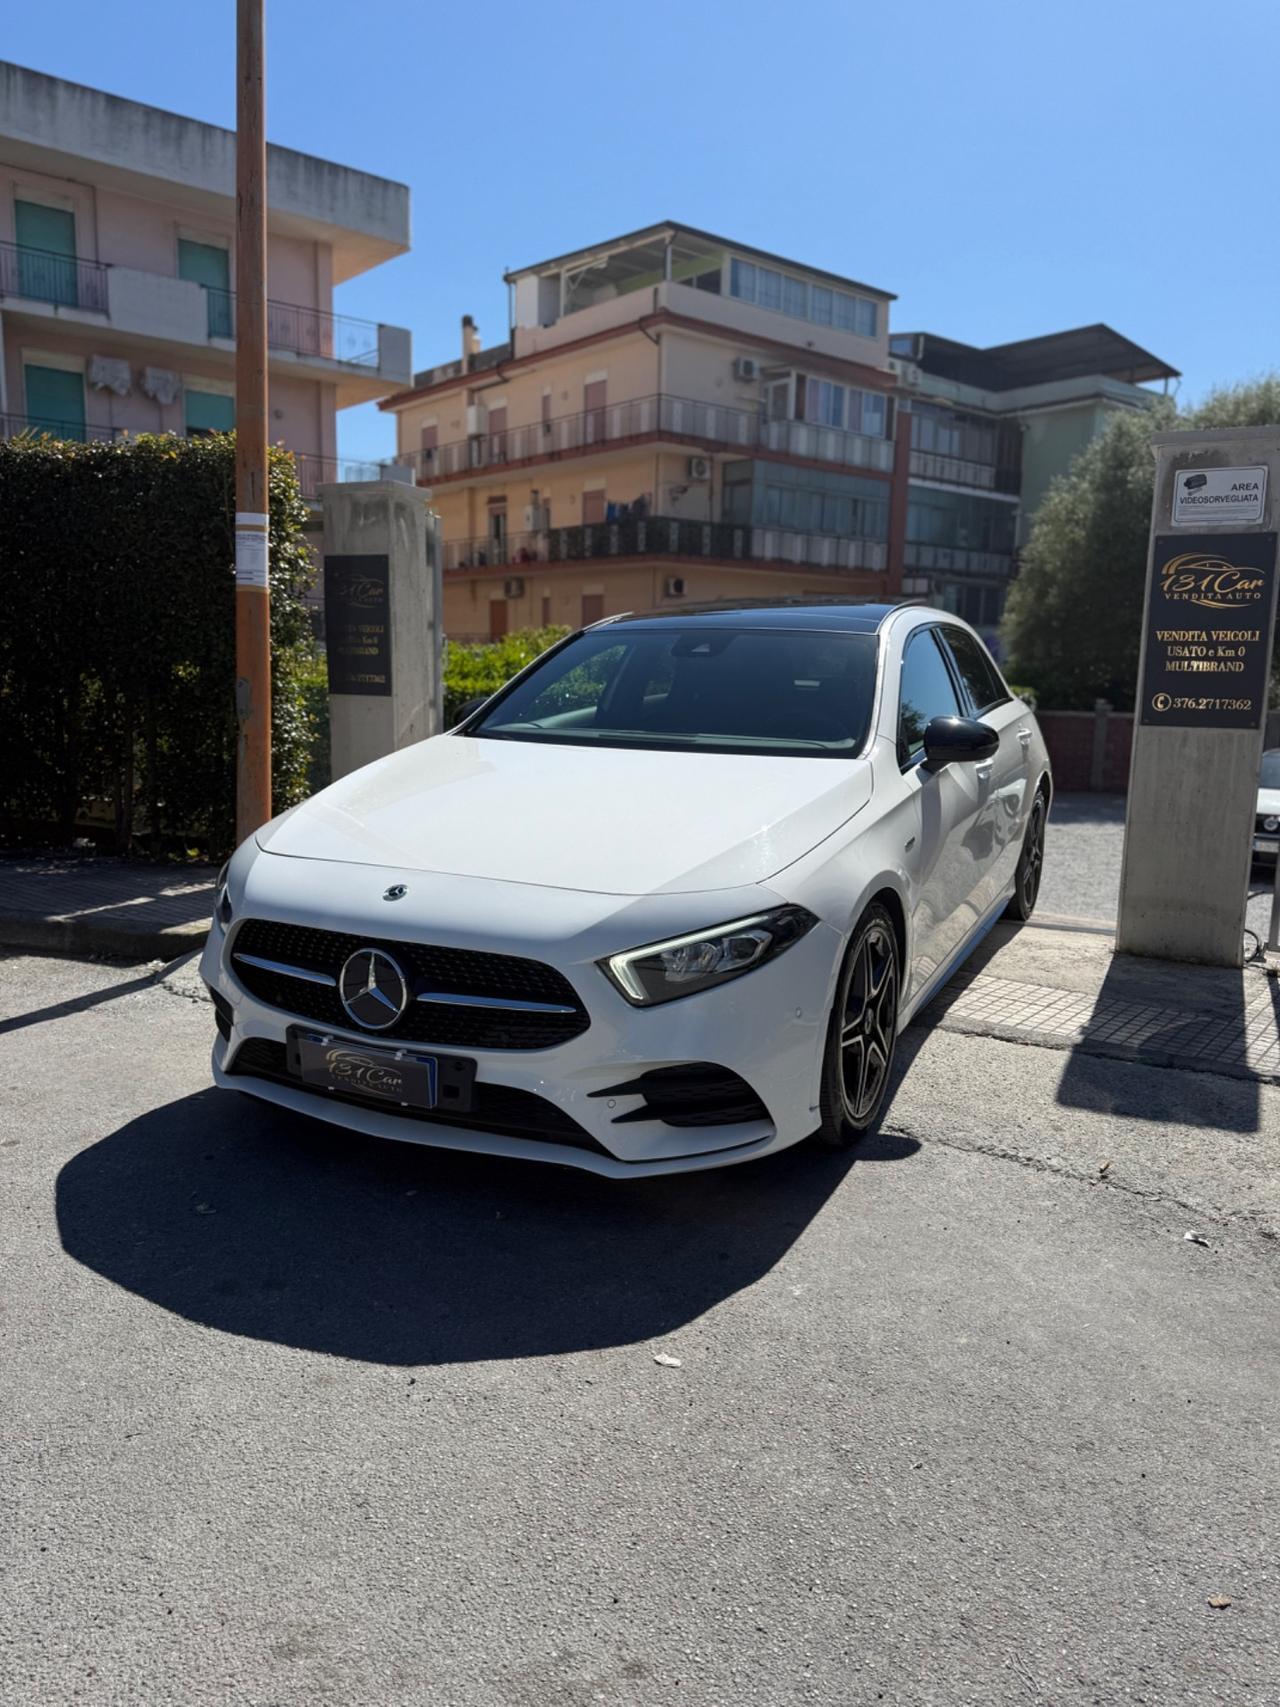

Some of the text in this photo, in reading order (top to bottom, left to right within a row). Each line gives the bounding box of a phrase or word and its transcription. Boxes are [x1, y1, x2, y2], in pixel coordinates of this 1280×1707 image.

[1231, 482, 1259, 491] AREA
[1180, 494, 1259, 504] VIDEOSORVEGLIATA
[1165, 592, 1262, 600] VENDITA AUTO
[1155, 630, 1261, 641] VENDITA VEICOLI
[1167, 646, 1206, 657] USATO
[1208, 649, 1215, 657] e
[1217, 646, 1235, 657] Km
[1165, 661, 1244, 672] MULTIBRAND
[1173, 697, 1252, 711] 376.2717362
